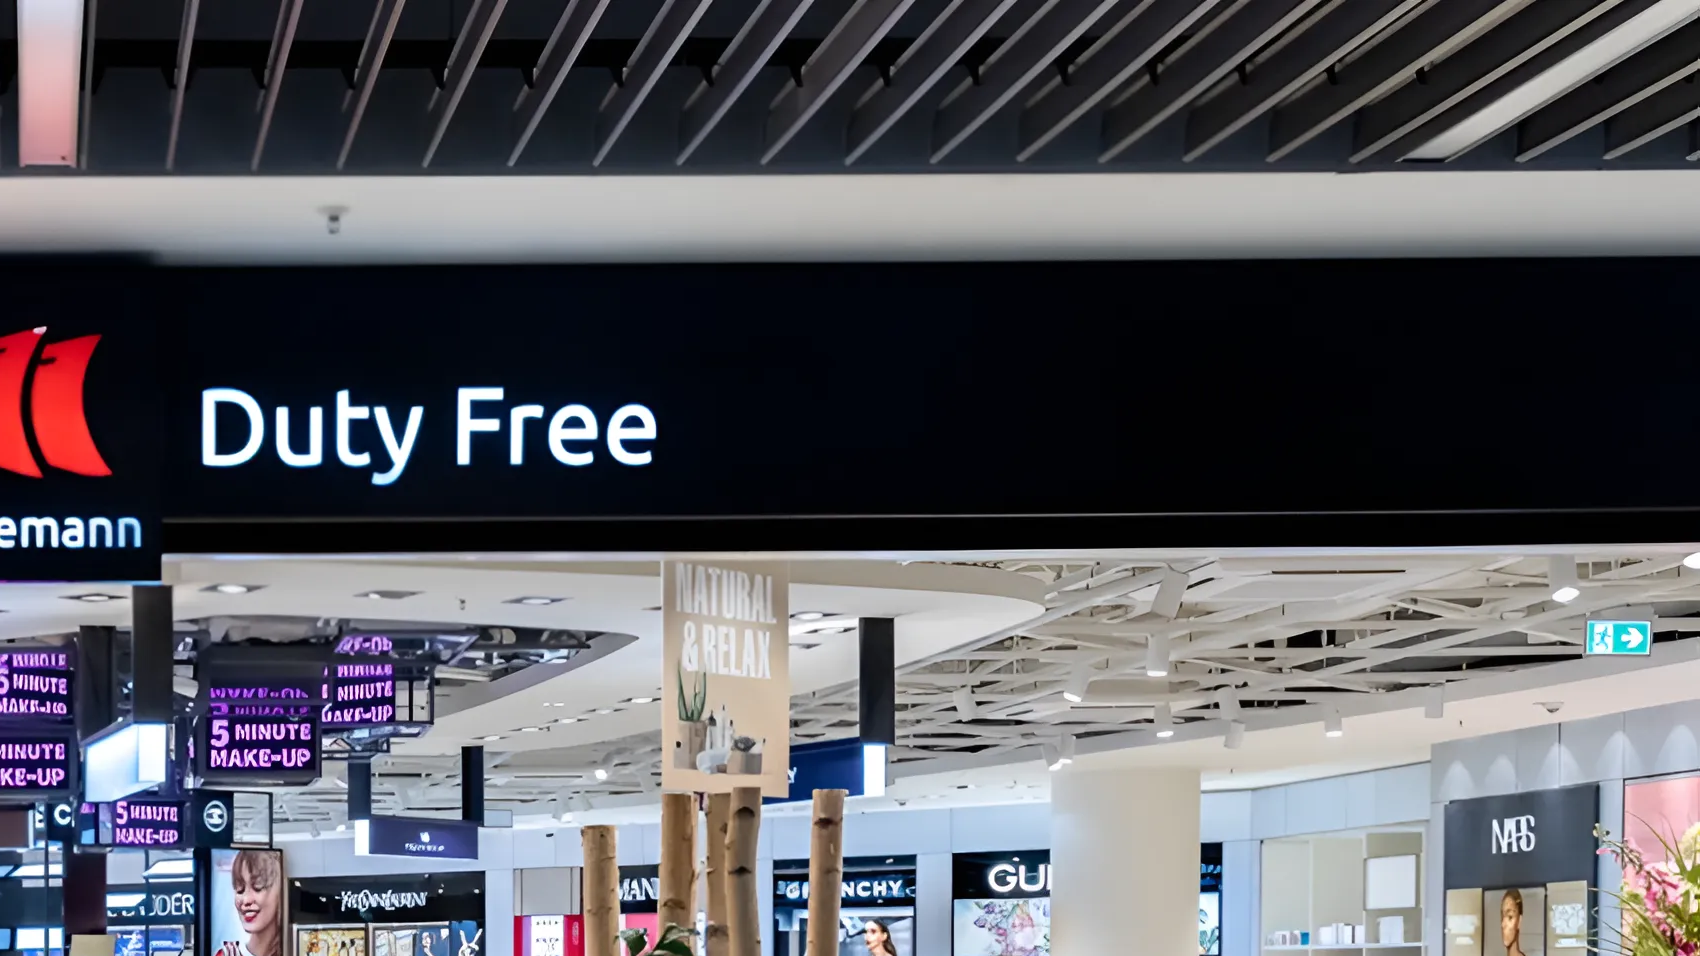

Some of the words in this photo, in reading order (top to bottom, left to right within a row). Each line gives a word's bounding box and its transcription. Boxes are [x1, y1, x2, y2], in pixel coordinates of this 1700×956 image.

[200, 388, 424, 485] Duty
[456, 386, 658, 467] Free
[675, 562, 777, 624] NATURAL
[682, 620, 699, 672] &
[702, 623, 772, 679] RELAX
[210, 719, 230, 747] 5
[234, 723, 312, 741] MINUTE
[210, 748, 312, 768] MAKE-UP
[115, 800, 129, 825] 5
[1491, 814, 1536, 854] NARS
[785, 879, 903, 899] GINCHY
[988, 862, 1051, 893] GU
